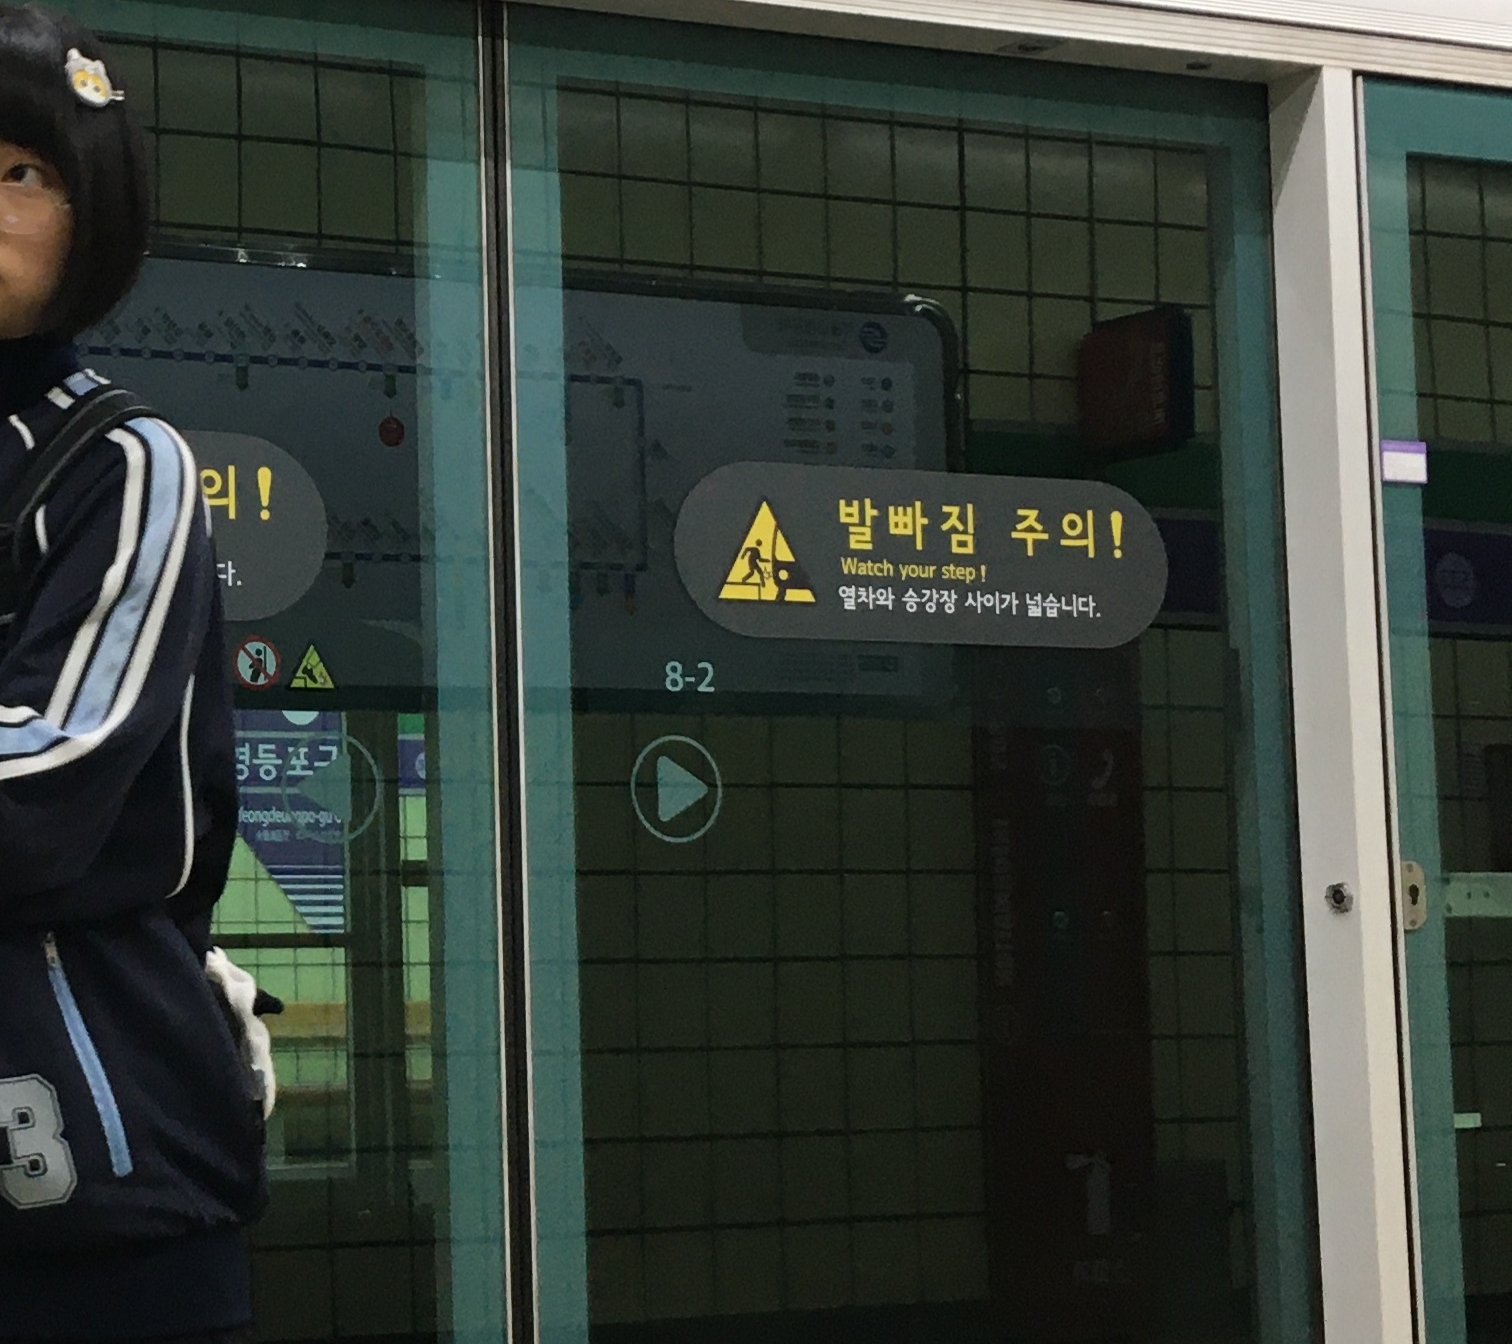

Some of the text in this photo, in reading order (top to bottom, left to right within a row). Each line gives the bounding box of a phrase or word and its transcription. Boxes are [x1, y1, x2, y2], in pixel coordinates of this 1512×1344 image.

[838, 497, 1124, 560] 발빠짐 주의!
[841, 557, 893, 577] Watch
[899, 562, 936, 581] your
[838, 585, 1102, 618] 열차와 승강장 사이가 넓습니다.
[664, 661, 716, 693] 8-2
